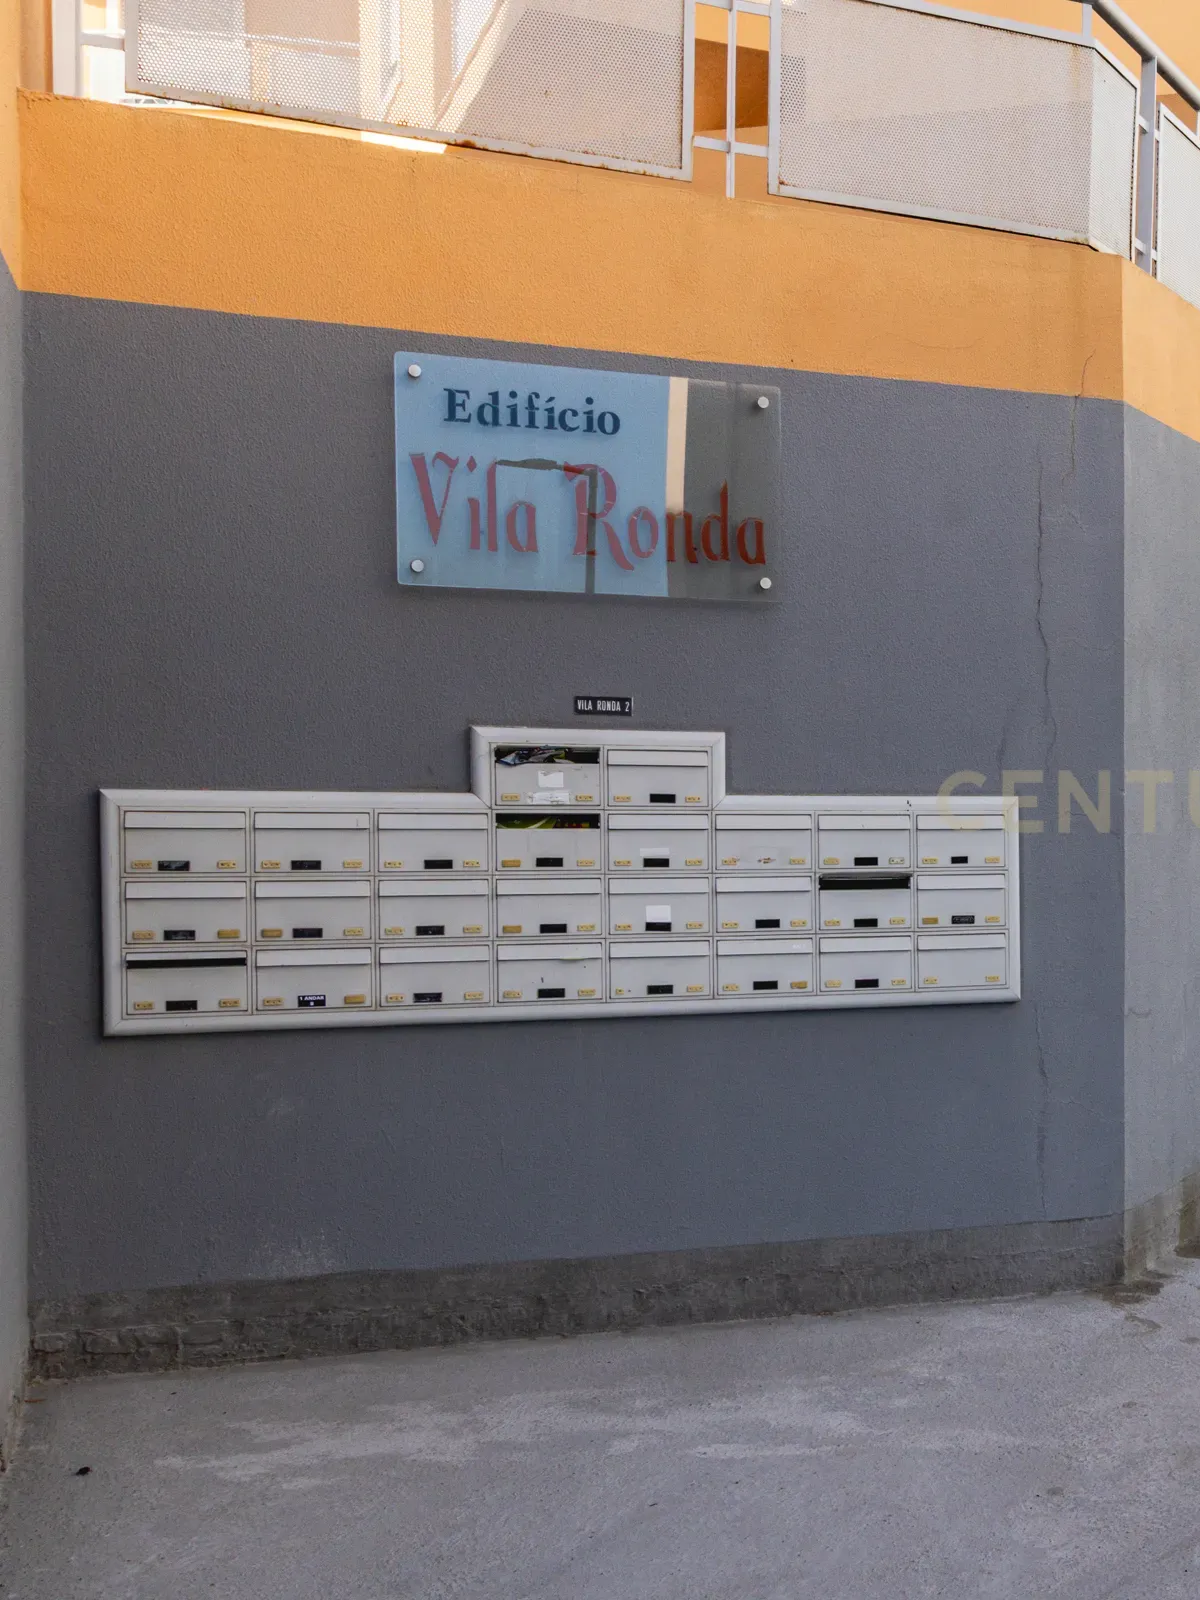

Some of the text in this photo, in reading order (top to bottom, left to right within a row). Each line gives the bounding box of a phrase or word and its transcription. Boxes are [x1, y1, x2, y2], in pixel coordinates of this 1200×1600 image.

[443, 388, 621, 436] Edifício
[409, 451, 766, 571] Vila Ronda
[577, 699, 630, 712] VILA RONDA 2
